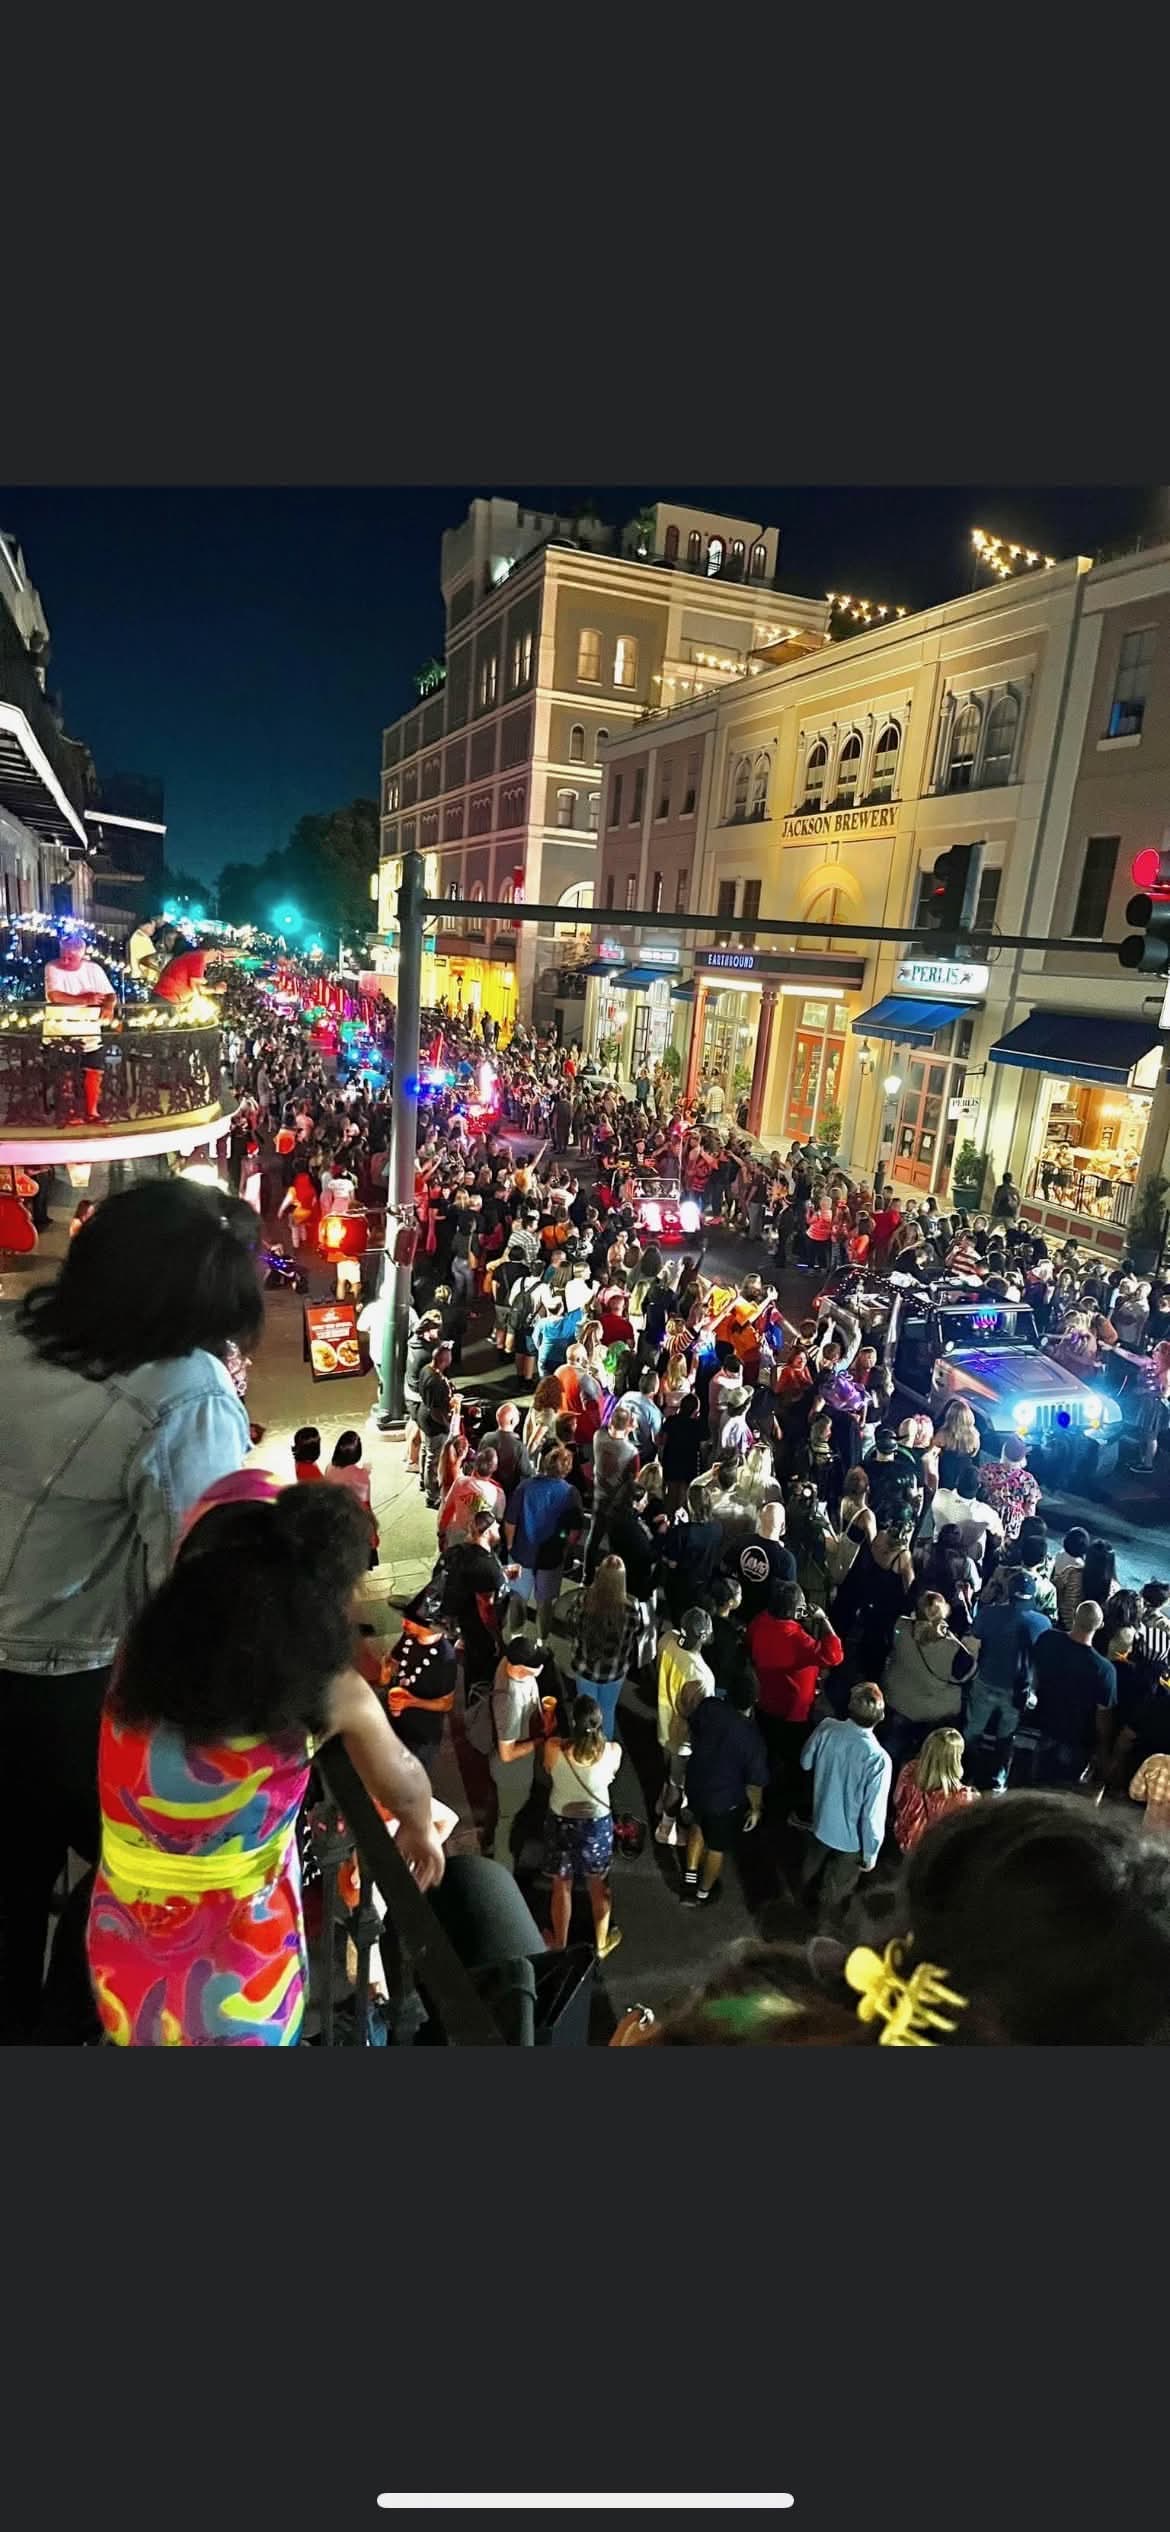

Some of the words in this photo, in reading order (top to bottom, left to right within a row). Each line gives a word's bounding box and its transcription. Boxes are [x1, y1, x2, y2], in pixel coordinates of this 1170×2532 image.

[782, 816, 832, 838] JACKSON
[834, 807, 899, 832] BREWERY
[708, 953, 754, 969] EARTHBOUND
[911, 965, 960, 985] PERLIS
[952, 1097, 980, 1107] PERLIS
